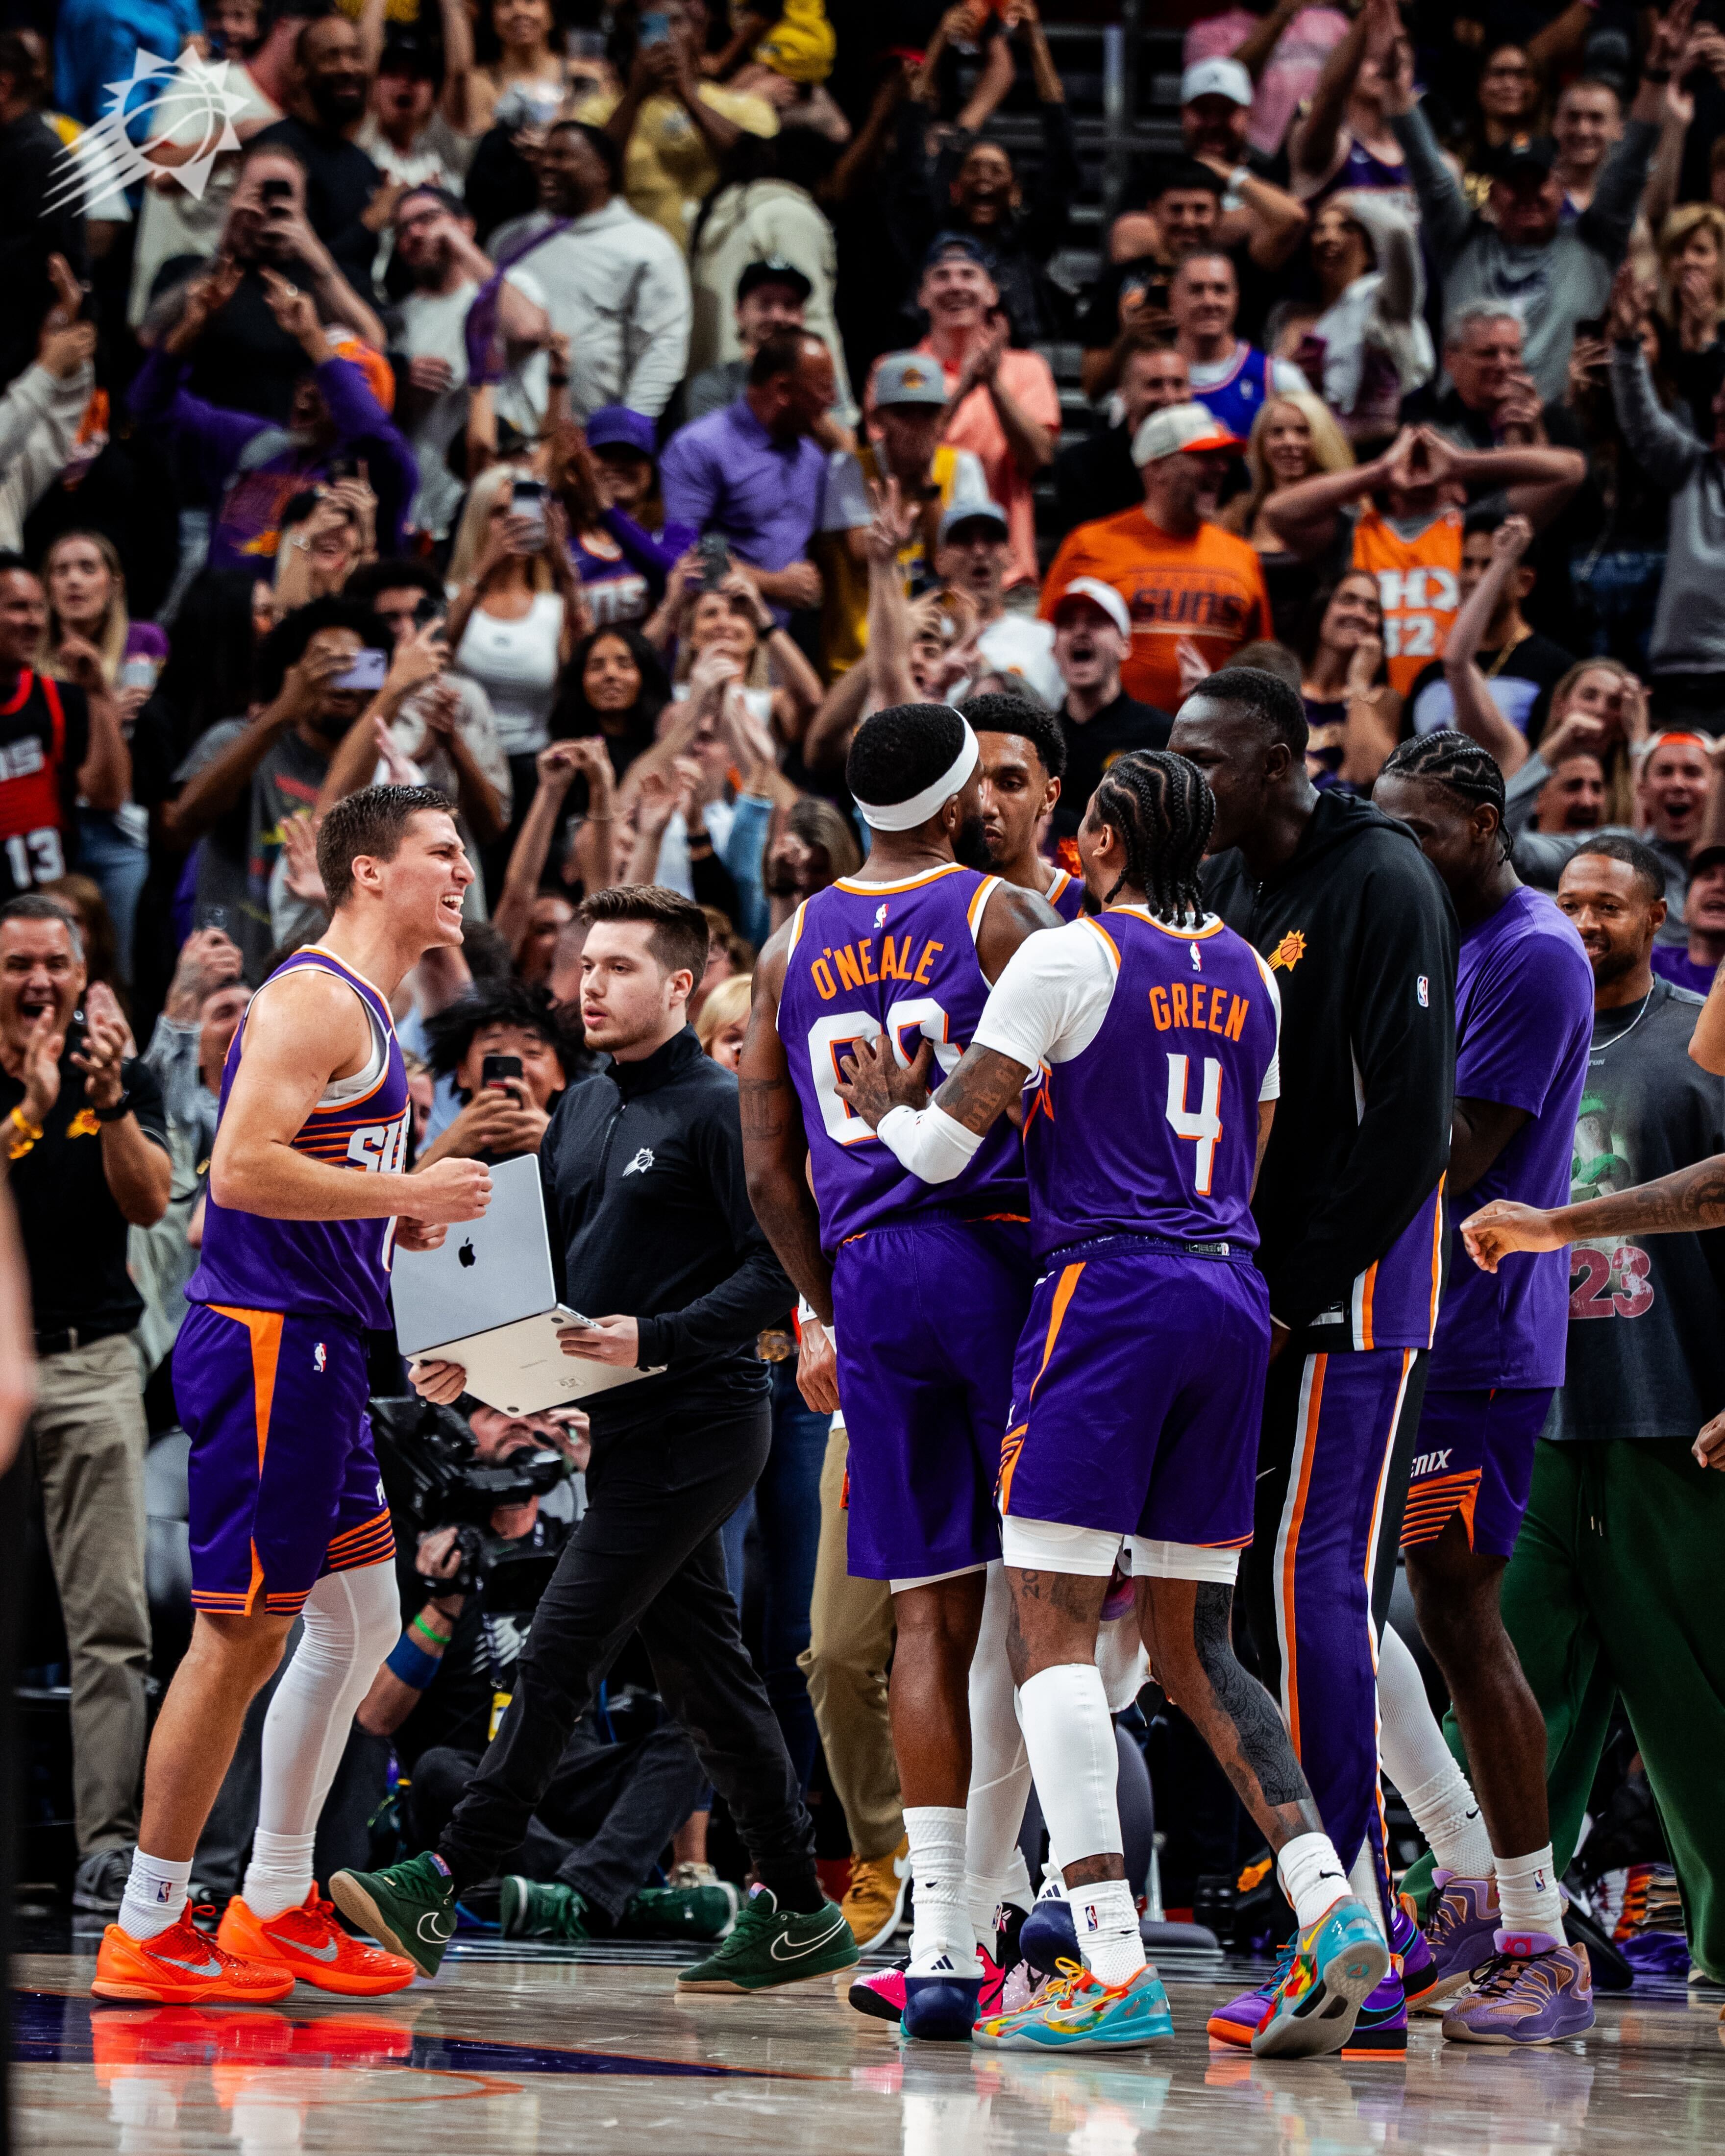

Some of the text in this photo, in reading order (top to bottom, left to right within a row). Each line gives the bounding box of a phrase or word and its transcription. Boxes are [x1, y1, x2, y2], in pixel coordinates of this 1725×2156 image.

[5, 827, 65, 888] 13
[811, 935, 944, 1001] O'NEALE
[1149, 983, 1249, 1042] GREEN
[1165, 1053, 1223, 1196] 4
[1568, 1246, 1654, 1319] 23
